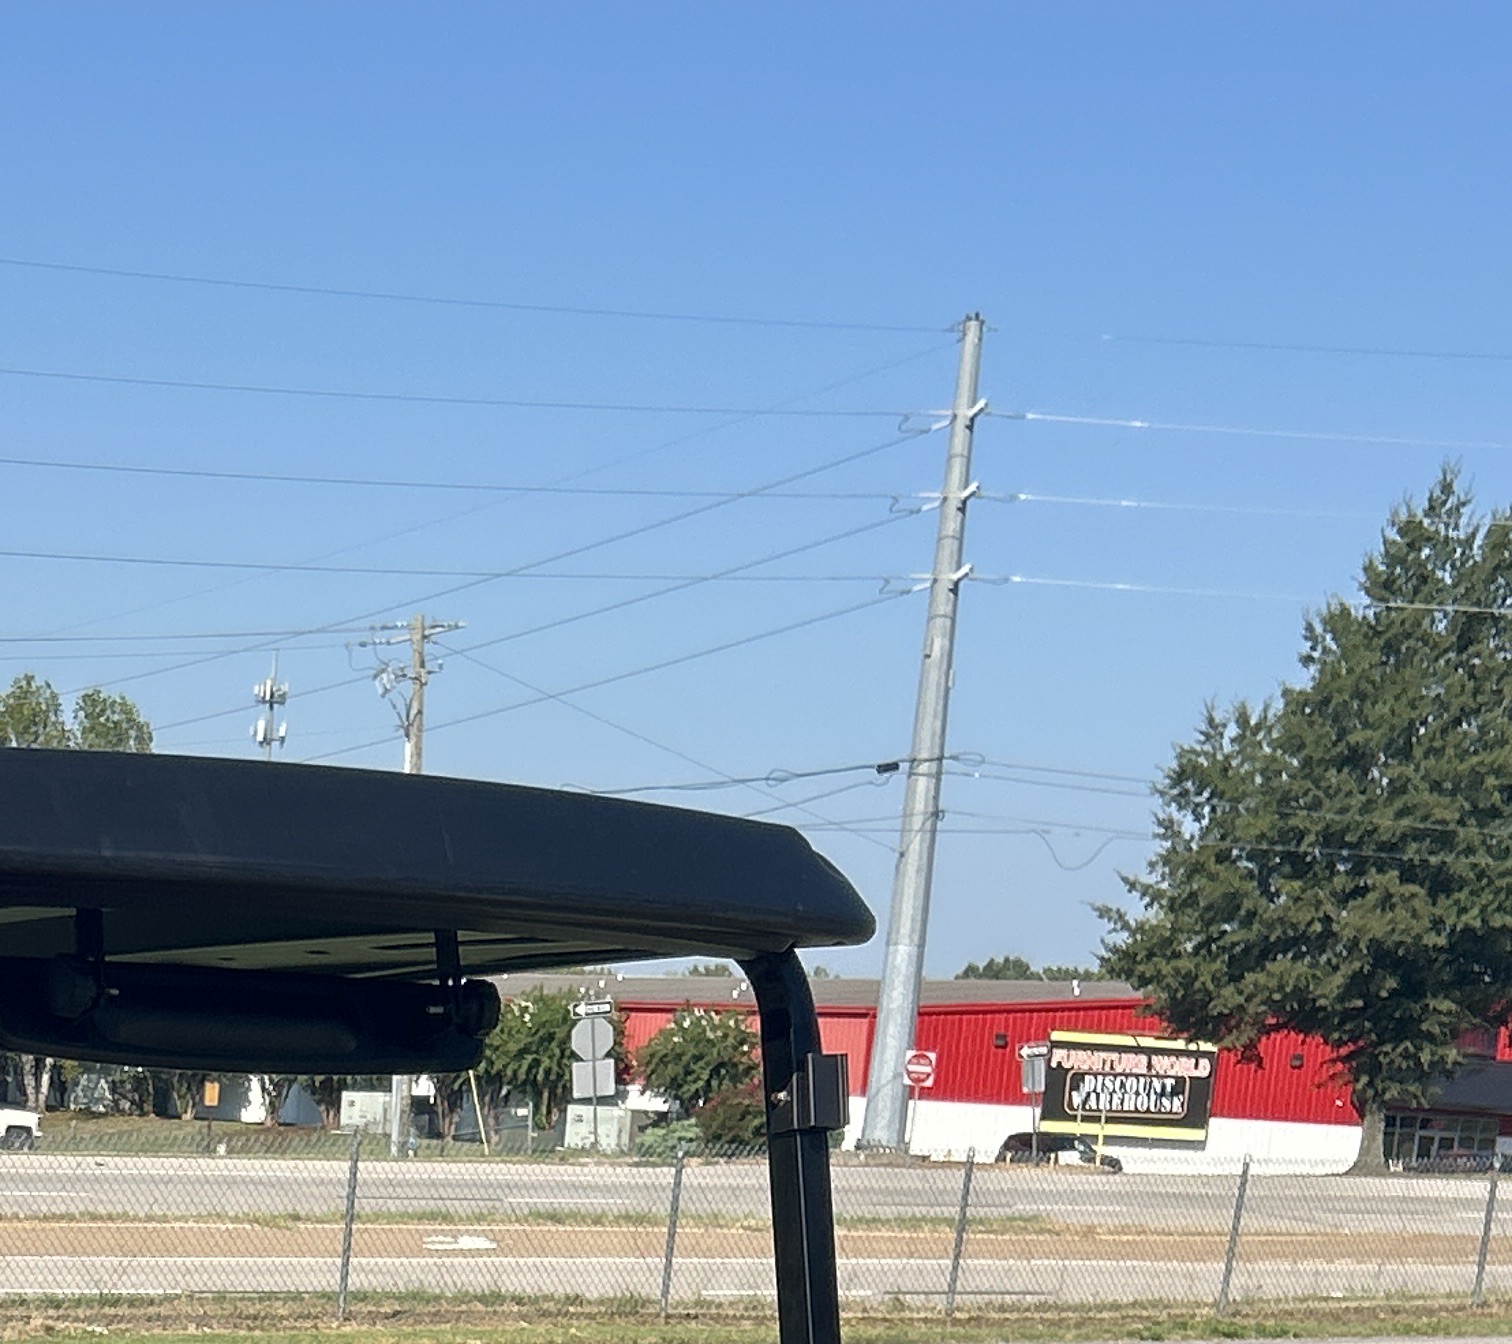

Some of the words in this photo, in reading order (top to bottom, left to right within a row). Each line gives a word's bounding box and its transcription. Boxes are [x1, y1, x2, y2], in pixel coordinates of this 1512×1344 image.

[1051, 1048, 1148, 1073] FURNITURE
[1151, 1054, 1211, 1077] WORLD
[1084, 1075, 1176, 1094] DISCOUNT
[1071, 1091, 1184, 1113] WAREHOUSE
